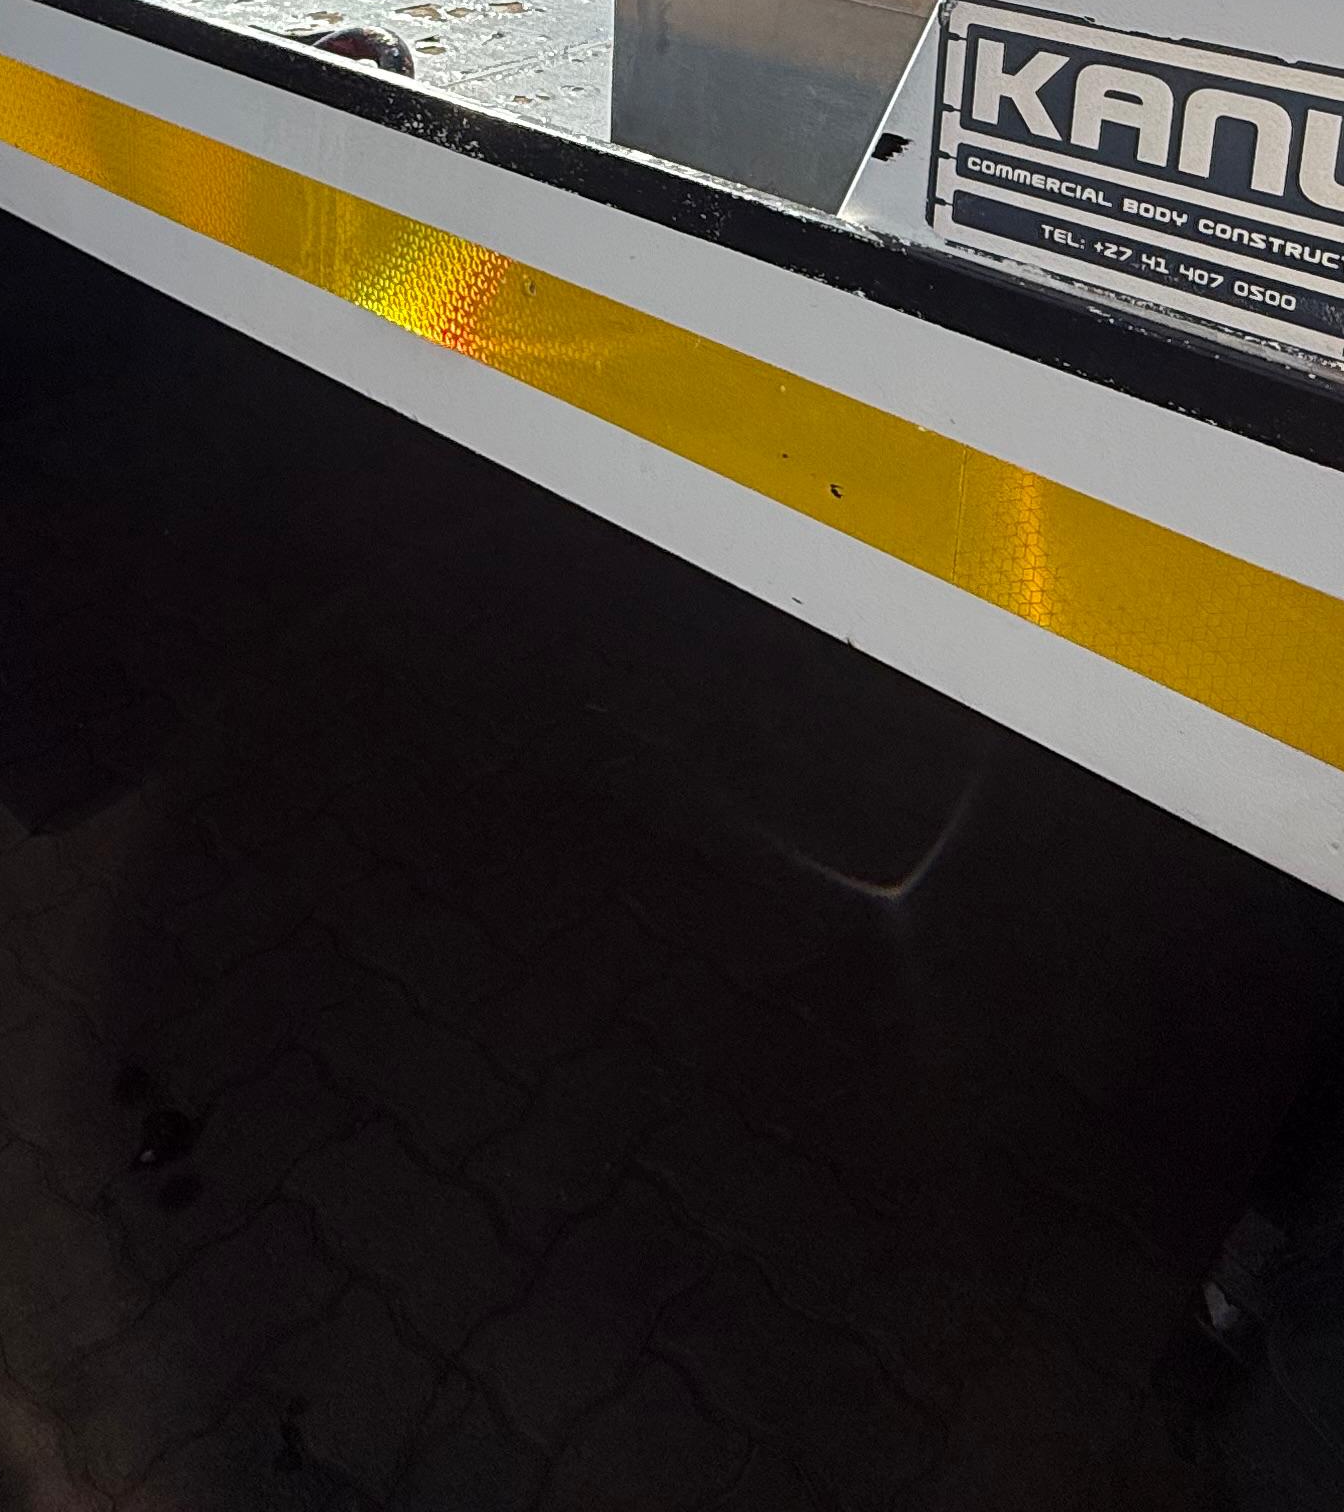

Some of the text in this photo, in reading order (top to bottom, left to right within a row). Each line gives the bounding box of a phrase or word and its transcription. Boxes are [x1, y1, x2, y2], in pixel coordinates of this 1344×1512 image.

[967, 156, 1112, 208] COMMERCIAL
[1122, 197, 1189, 227] BODY
[1041, 224, 1297, 312] TEL: +27 41 407 0500
